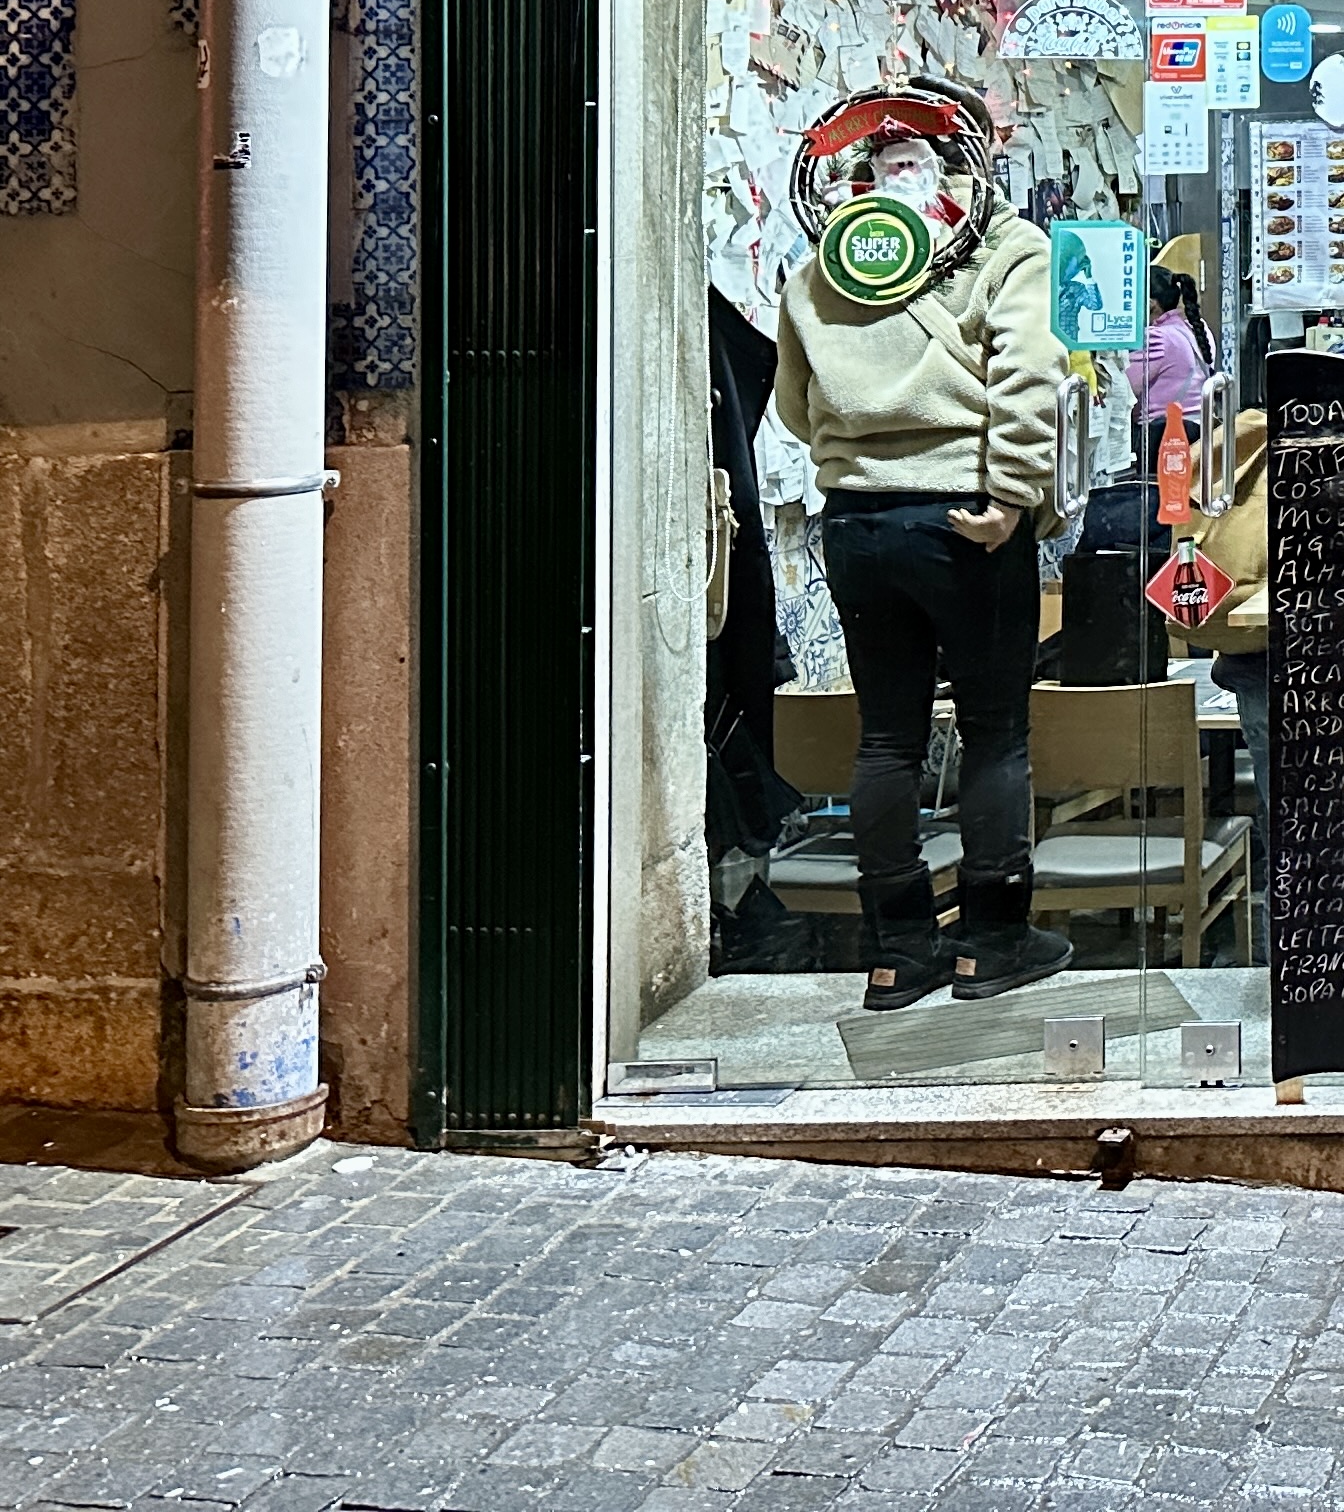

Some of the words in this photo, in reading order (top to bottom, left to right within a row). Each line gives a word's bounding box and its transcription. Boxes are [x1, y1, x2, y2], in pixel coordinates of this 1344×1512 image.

[851, 235, 901, 250] SUPER
[853, 248, 899, 263] BOCK
[1122, 230, 1135, 311] EMPURRE
[1107, 313, 1133, 326] Lyca
[1280, 977, 1335, 1004] SOPA
